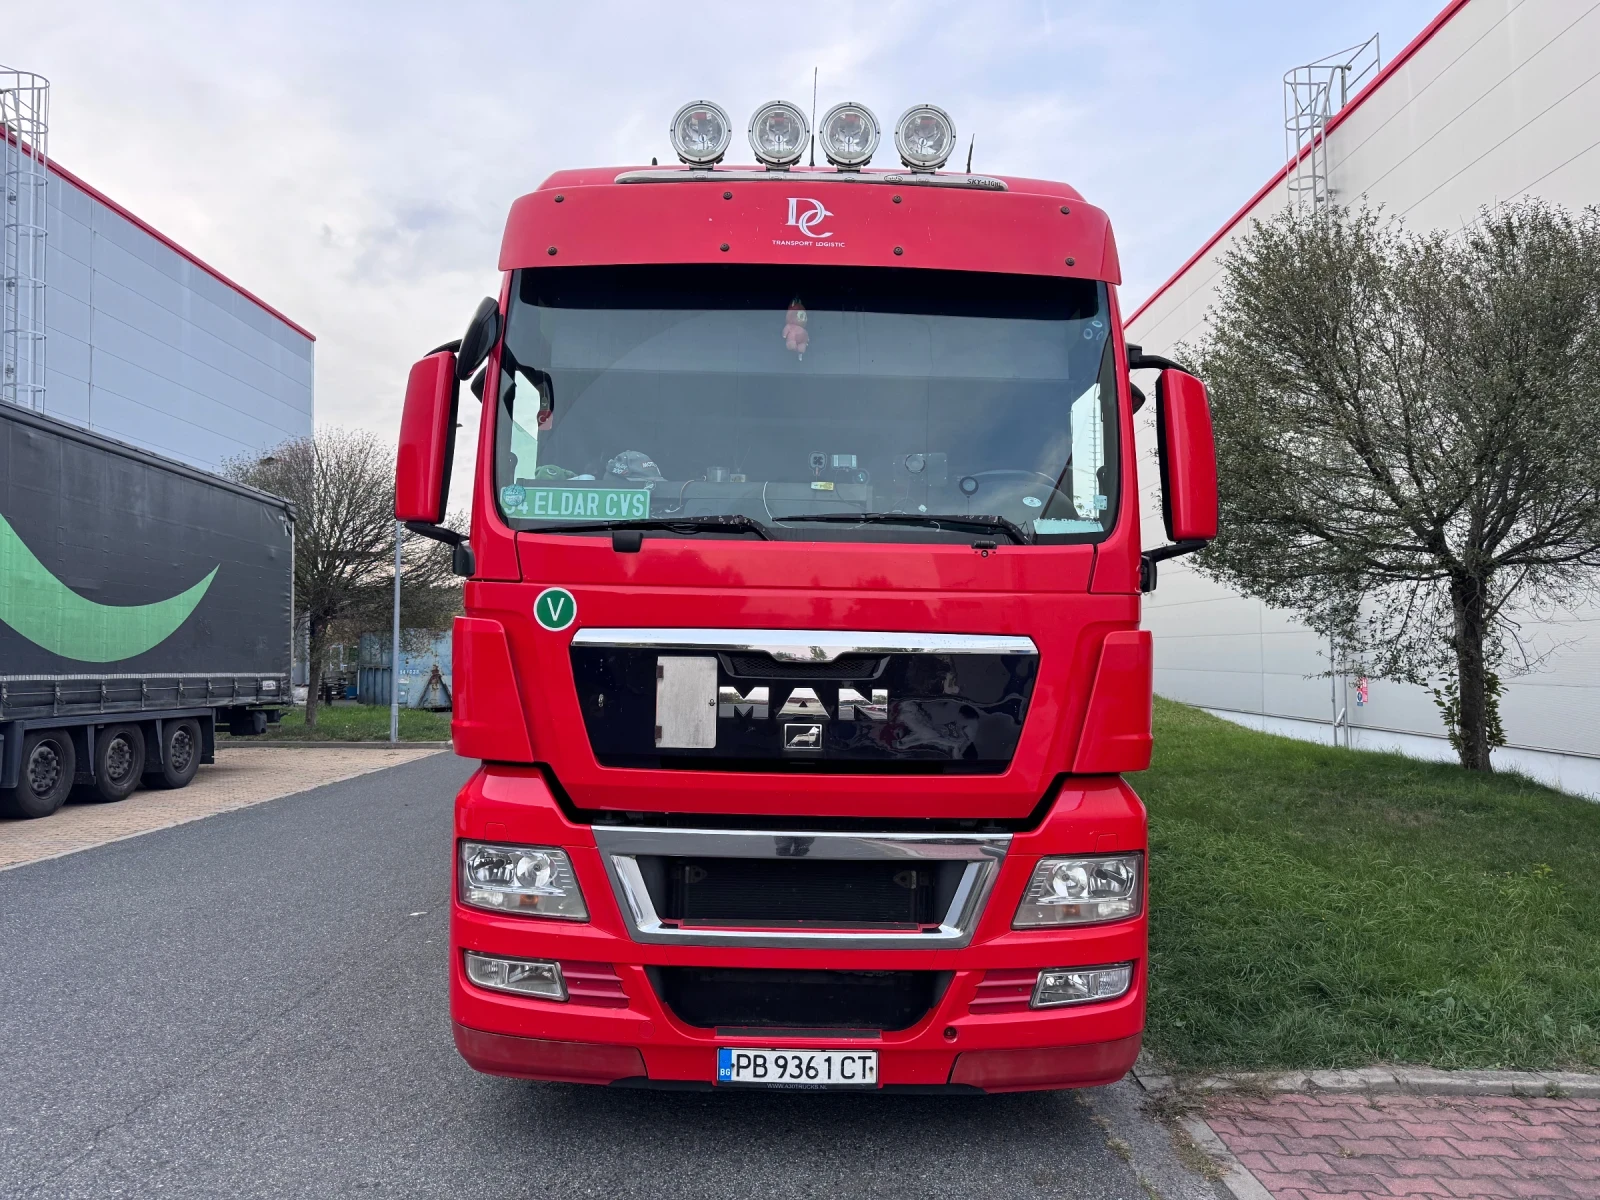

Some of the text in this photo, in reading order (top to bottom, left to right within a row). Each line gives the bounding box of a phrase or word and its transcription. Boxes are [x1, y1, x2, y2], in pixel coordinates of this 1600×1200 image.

[534, 491, 599, 516] ELDAR
[605, 493, 645, 517] CVS
[546, 597, 565, 621] V
[719, 686, 888, 720] MAN
[720, 1054, 872, 1080] BG PB 9361 CT
